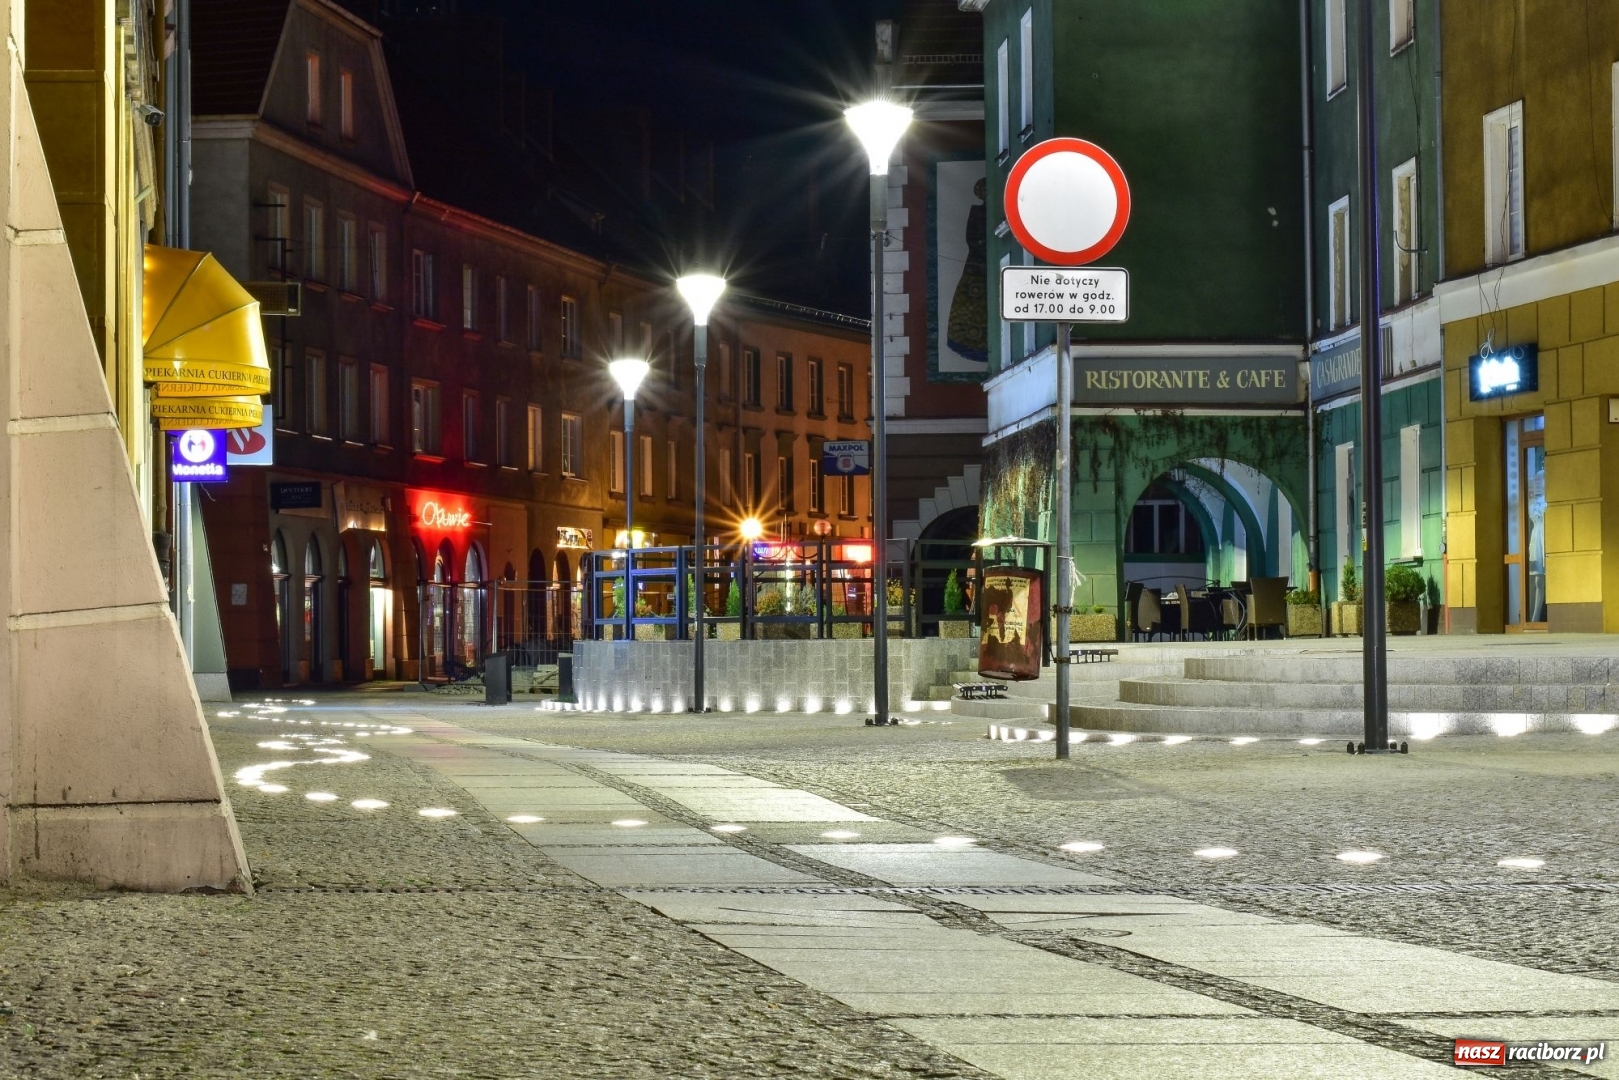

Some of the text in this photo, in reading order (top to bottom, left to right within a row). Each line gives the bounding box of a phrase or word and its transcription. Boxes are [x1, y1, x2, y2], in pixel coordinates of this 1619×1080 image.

[1030, 275, 1100, 288] Nie dotyczy
[1015, 289, 1115, 303] rowerów w godz.
[1014, 304, 1116, 314] od 17.00 do 9.00
[145, 367, 205, 378] PIEKARNIA
[208, 370, 252, 382] CUKIERNIA
[1316, 347, 1362, 389] CASAGRANDE
[1085, 369, 1286, 390] RISTORANTE & CAFE
[152, 404, 206, 414] PIEKARNIA
[208, 405, 248, 417] CUKIERNIA
[829, 444, 864, 452] MAXPOL
[172, 463, 224, 476] Monetia
